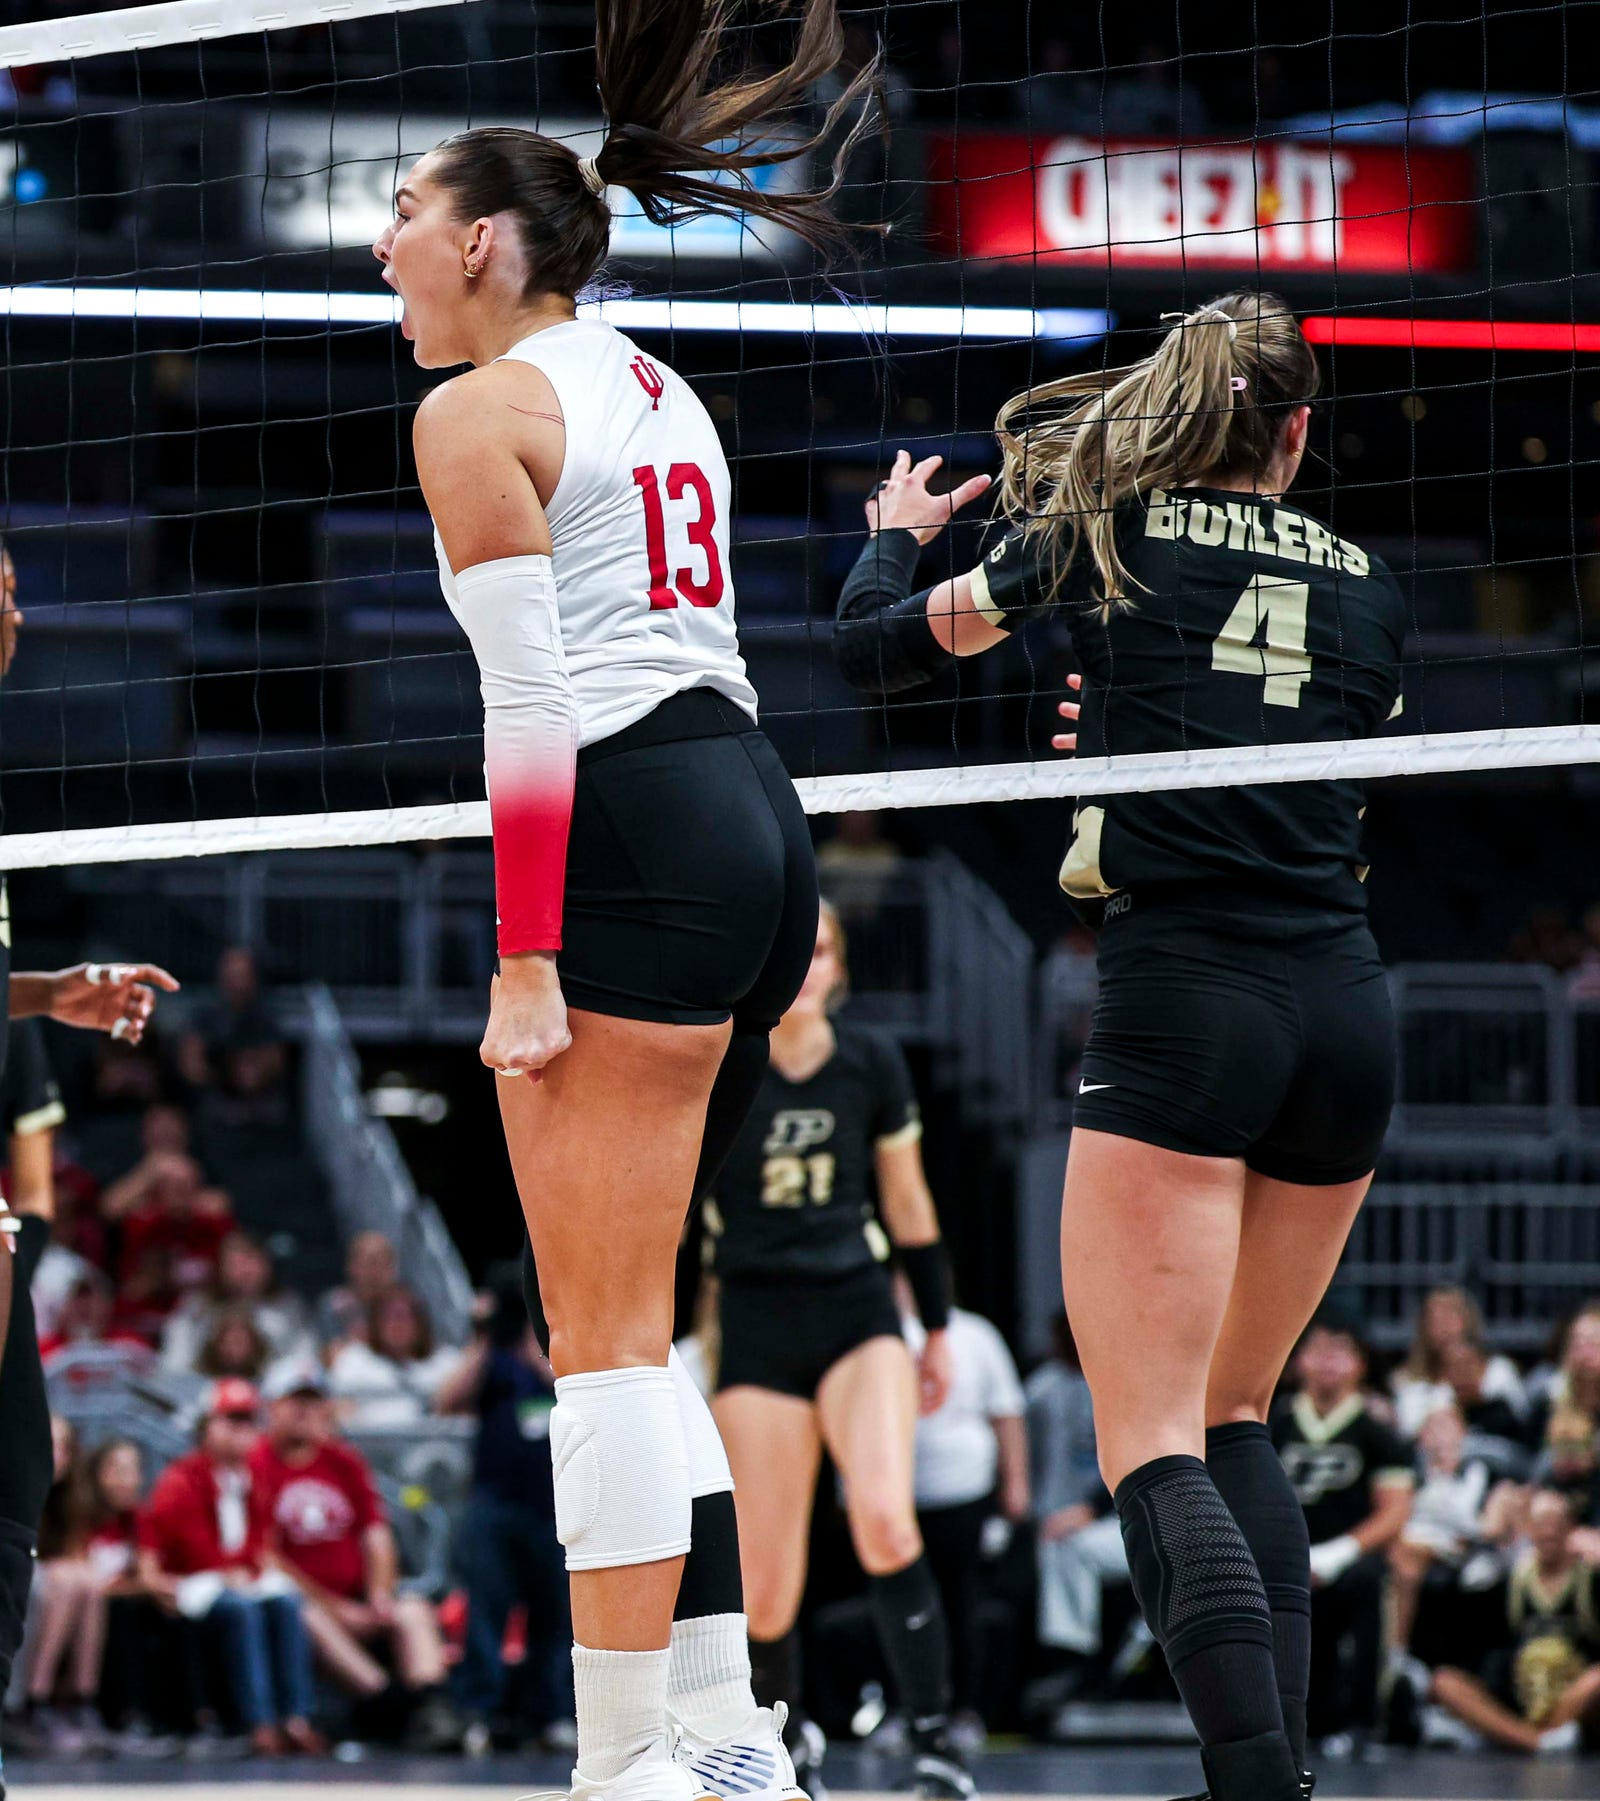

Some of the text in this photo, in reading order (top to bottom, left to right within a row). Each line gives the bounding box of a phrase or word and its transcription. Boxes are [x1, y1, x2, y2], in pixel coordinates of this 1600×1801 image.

[632, 462, 725, 611] 13
[1211, 572, 1312, 709] 4
[761, 1152, 835, 1208] 21
